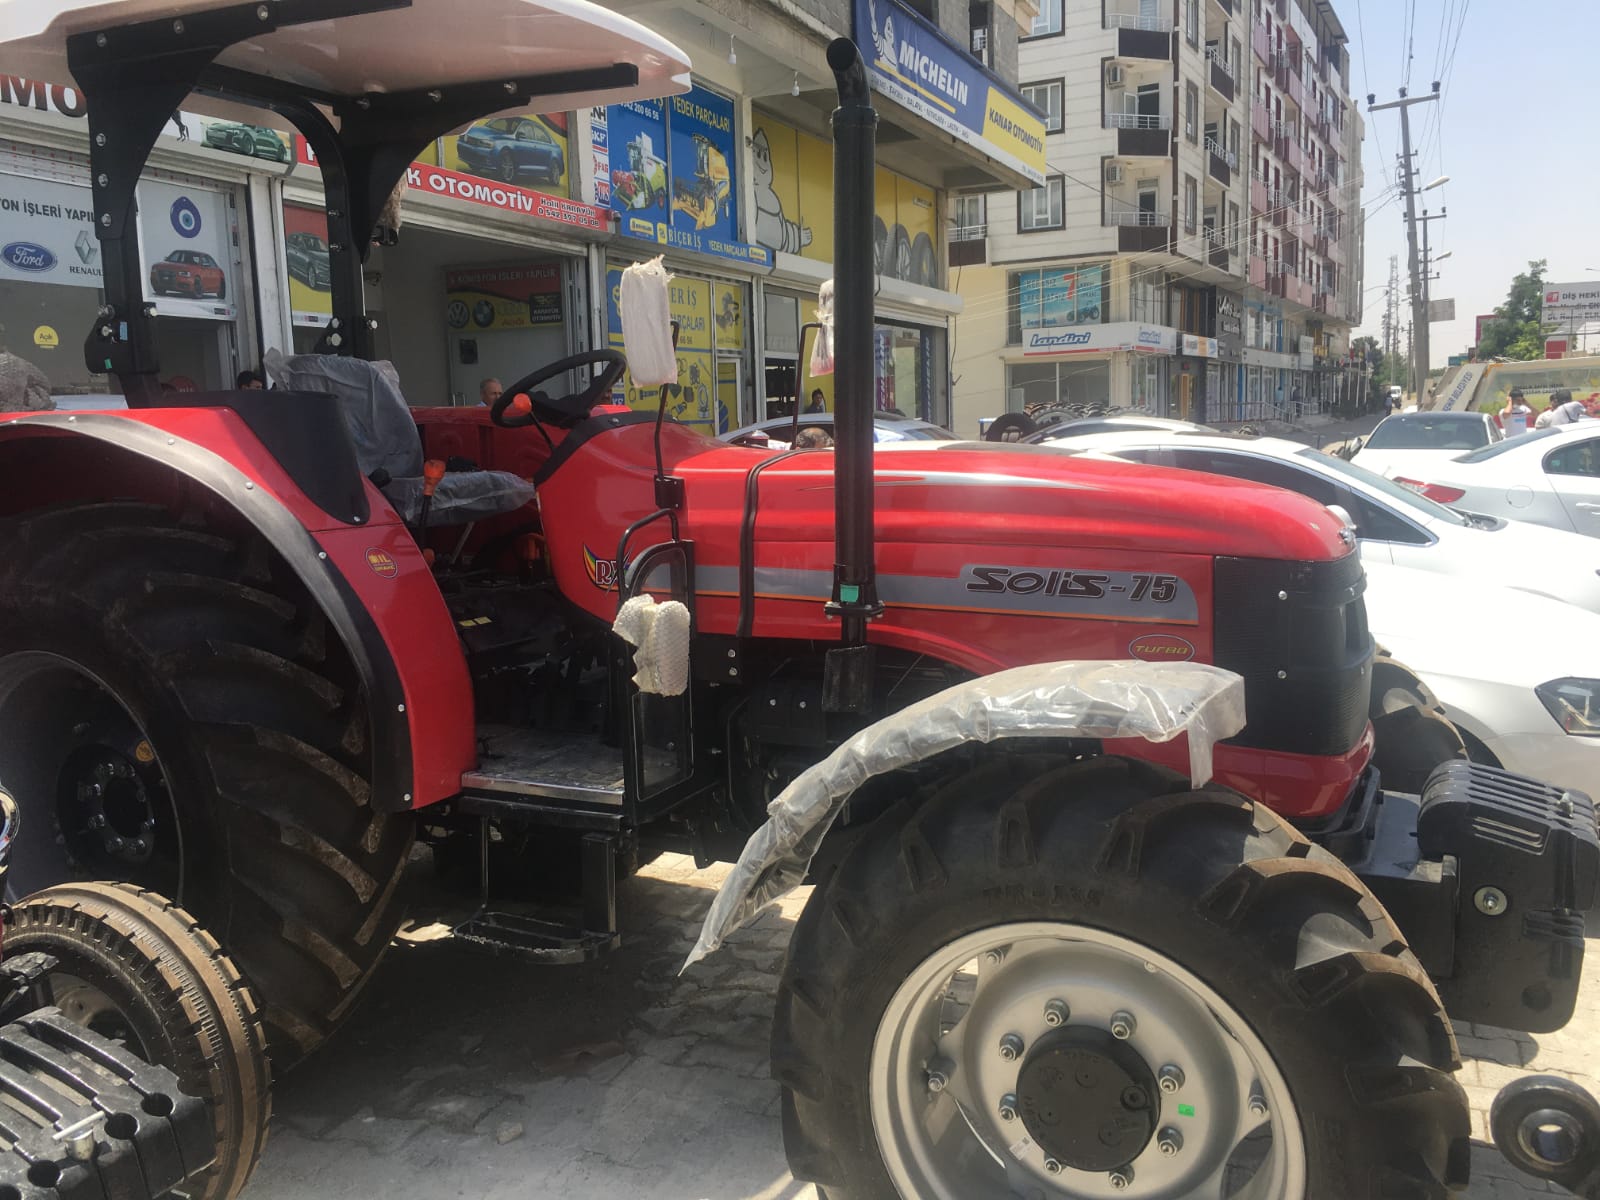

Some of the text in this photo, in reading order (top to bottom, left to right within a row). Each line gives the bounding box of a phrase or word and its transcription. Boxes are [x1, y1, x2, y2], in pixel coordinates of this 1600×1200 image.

[899, 40, 969, 106] MICHELIN
[673, 95, 730, 133] YEDEK PARÇALARI
[989, 107, 1043, 153] KANAR OTOMOTİV
[429, 173, 533, 212] OTOMOTİV
[0, 198, 19, 212] ON
[23, 198, 62, 217] İŞLERİ
[668, 227, 693, 248] BİÇER
[12, 246, 45, 267] Ford
[1135, 645, 1188, 655] TURBO
